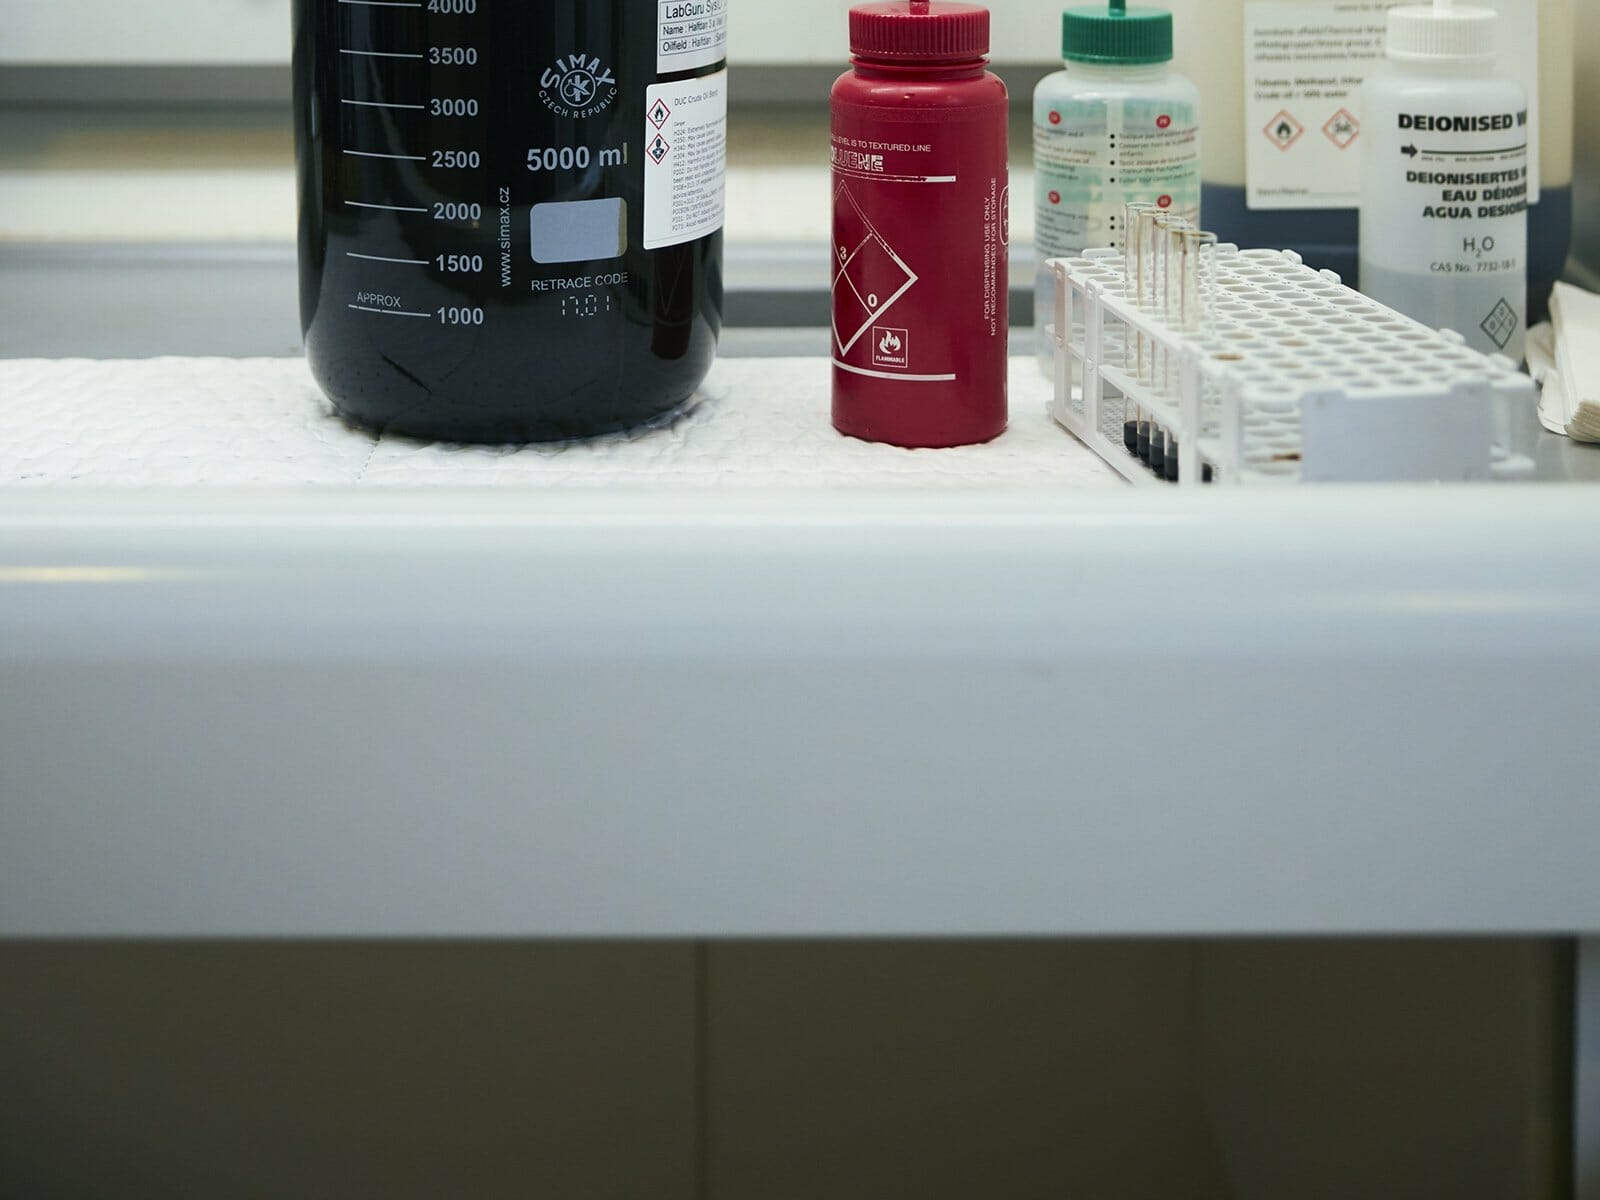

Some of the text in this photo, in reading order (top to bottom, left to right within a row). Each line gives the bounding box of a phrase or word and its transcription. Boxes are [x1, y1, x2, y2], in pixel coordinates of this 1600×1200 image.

[665, 2, 705, 19] LabGuru
[663, 24, 684, 36] Name
[663, 40, 688, 52] Oilfield
[429, 47, 478, 65] 3500
[540, 53, 616, 88] SIMAX
[430, 99, 479, 117] 3000
[538, 86, 619, 119] CZECH REPUBLIC
[1398, 113, 1513, 132] DEIONISED
[858, 140, 867, 149] TO
[868, 141, 911, 152] TEXTURED
[912, 144, 931, 153] LINE
[432, 150, 480, 169] 2500
[526, 141, 628, 171] 5000 ml
[1406, 166, 1519, 185] DEIONISIERTES
[1442, 189, 1477, 202] EAU
[433, 202, 481, 220] 2000
[1422, 206, 1472, 219] AGUA
[499, 186, 510, 287] www.simax.cz
[435, 254, 483, 273] 1500
[1430, 261, 1452, 273] CAS
[531, 272, 629, 291] RETRACE CODE
[356, 291, 401, 307] APPROX
[867, 293, 878, 308] 0
[437, 307, 484, 325] 1000
[875, 355, 905, 364] FLAMMABLE
